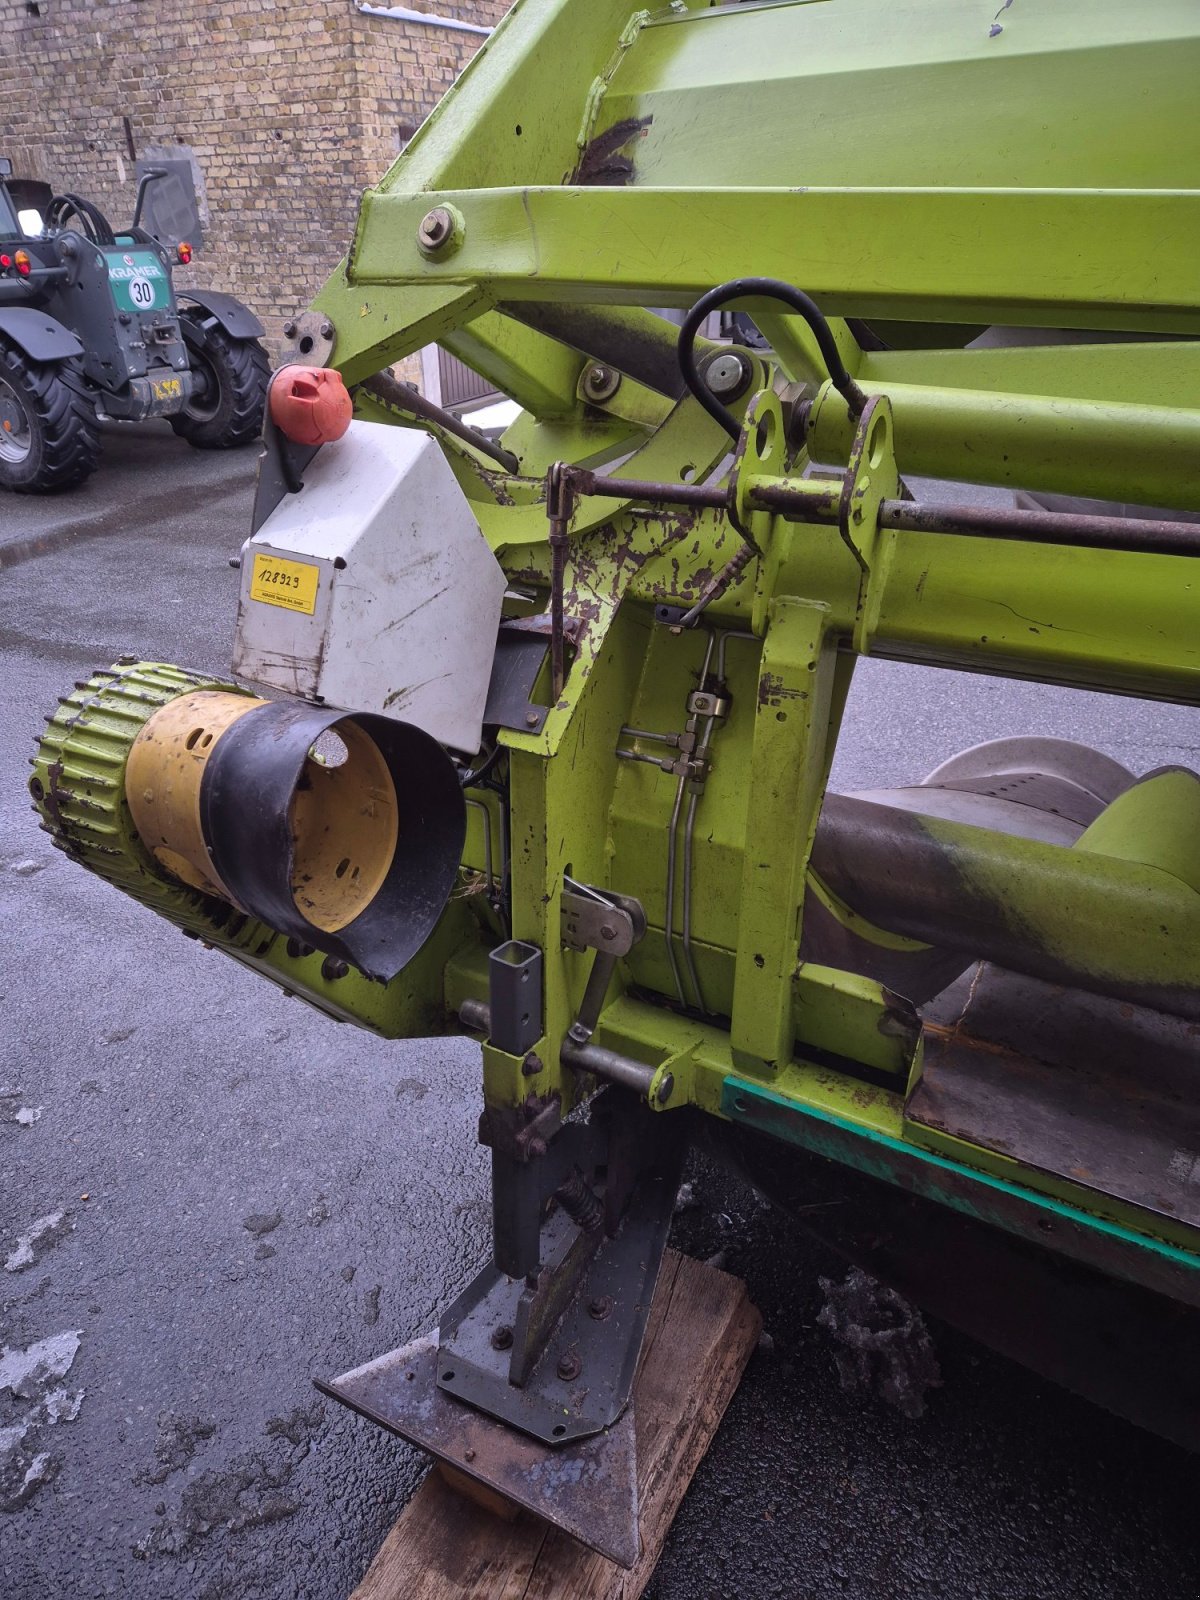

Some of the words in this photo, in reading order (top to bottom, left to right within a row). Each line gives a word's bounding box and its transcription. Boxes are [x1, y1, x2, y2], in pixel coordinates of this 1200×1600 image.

[109, 266, 161, 278] KRAMER
[133, 283, 151, 302] 30
[258, 569, 300, 589] 128929
